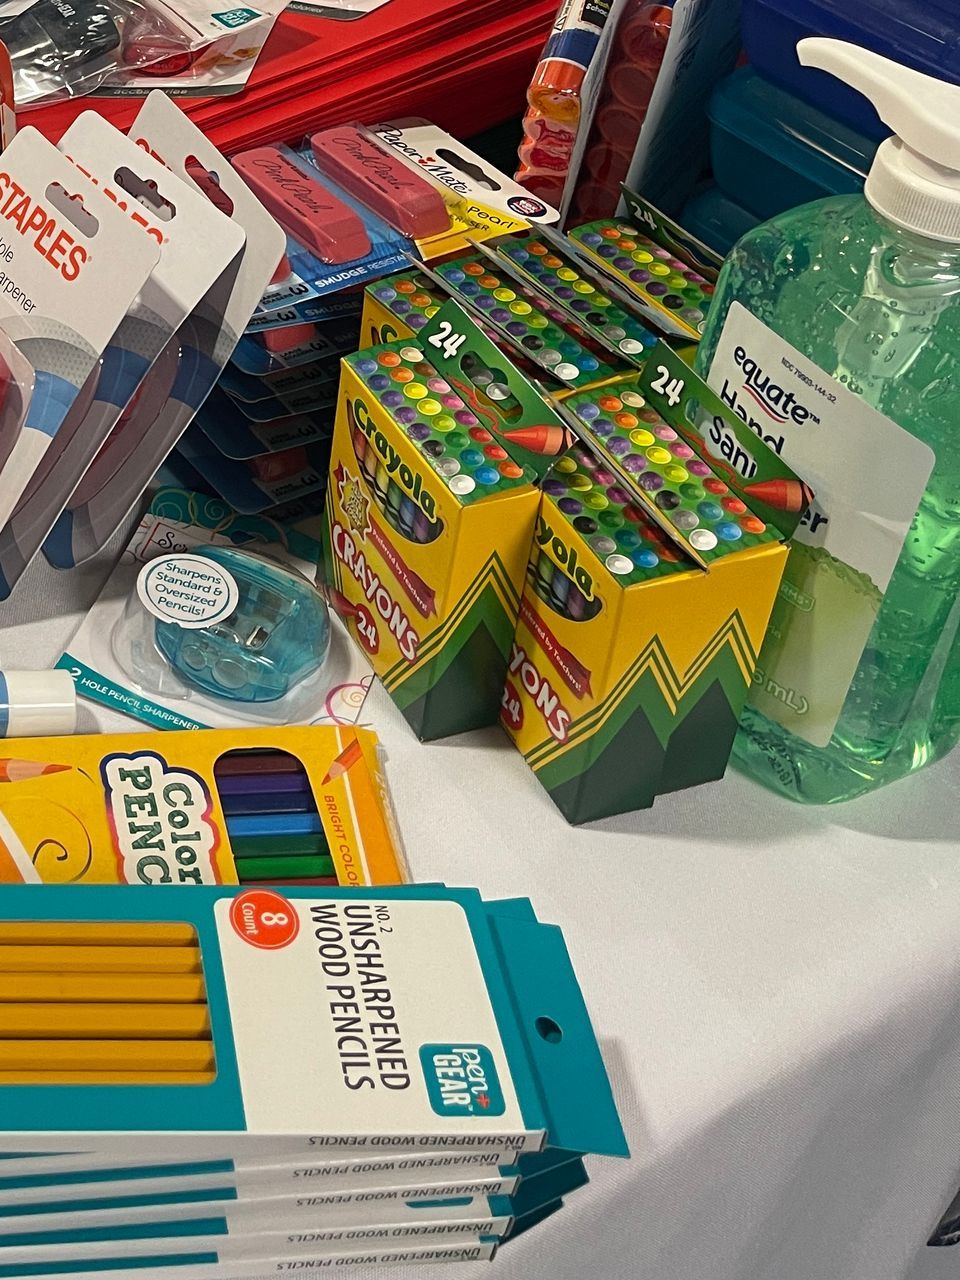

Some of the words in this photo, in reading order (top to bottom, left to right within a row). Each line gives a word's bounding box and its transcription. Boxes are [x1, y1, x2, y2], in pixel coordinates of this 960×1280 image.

[375, 123, 424, 161] Paper
[427, 164, 469, 195] Mate
[466, 206, 515, 229] Pearl
[633, 206, 657, 229] 24
[314, 267, 368, 290] SMUDGE
[428, 321, 468, 359] 24
[649, 365, 685, 407] 24
[733, 345, 810, 426] equate
[354, 398, 437, 521] Crayola
[538, 516, 594, 600] yola
[165, 562, 222, 585] Sharpens
[372, 528, 395, 565] Preferred
[401, 570, 427, 612] Teachers!
[155, 572, 212, 594] Standard
[213, 585, 223, 596] &
[332, 523, 418, 661] CRAYONS
[154, 584, 217, 608] Oversized
[157, 596, 207, 617] Pencils!
[357, 612, 377, 648] 24
[553, 649, 582, 692] Teachers!
[70, 667, 81, 682] 2
[81, 677, 109, 695] HOLE
[109, 689, 142, 711] PENCIL
[141, 704, 200, 732] SHARPENER
[509, 643, 570, 742] YONS
[502, 687, 520, 722] 24
[118, 765, 172, 884] PENC
[324, 795, 347, 841] BRIGHT
[240, 902, 258, 935] Count
[260, 912, 289, 926] 8
[375, 905, 390, 924] NO.
[310, 903, 349, 977] WOOD
[380, 926, 392, 934] 2
[344, 904, 411, 1090] UNSHARPENED
[326, 984, 375, 1091] PENCILS
[432, 1054, 471, 1107] GEAR
[452, 1047, 490, 1109] pen+
[309, 1136, 367, 1145] PENCILS
[371, 1136, 415, 1145] WOOD
[420, 1135, 526, 1145] UNSHARPENED
[293, 1167, 348, 1178] PENCILS
[352, 1162, 394, 1173] WOOD
[398, 1153, 500, 1169] UNSHARPENED
[297, 1196, 352, 1206] PENCILS
[356, 1192, 398, 1202] WOOD
[401, 1183, 502, 1198] UNSHARPENED
[288, 1232, 342, 1243] PENCILS
[346, 1229, 389, 1239] WOOD
[392, 1223, 493, 1236] UNSHARPENED
[277, 1259, 332, 1270] PENCILS
[335, 1255, 378, 1266] WOOD
[381, 1248, 480, 1262] UNSHARPENED
